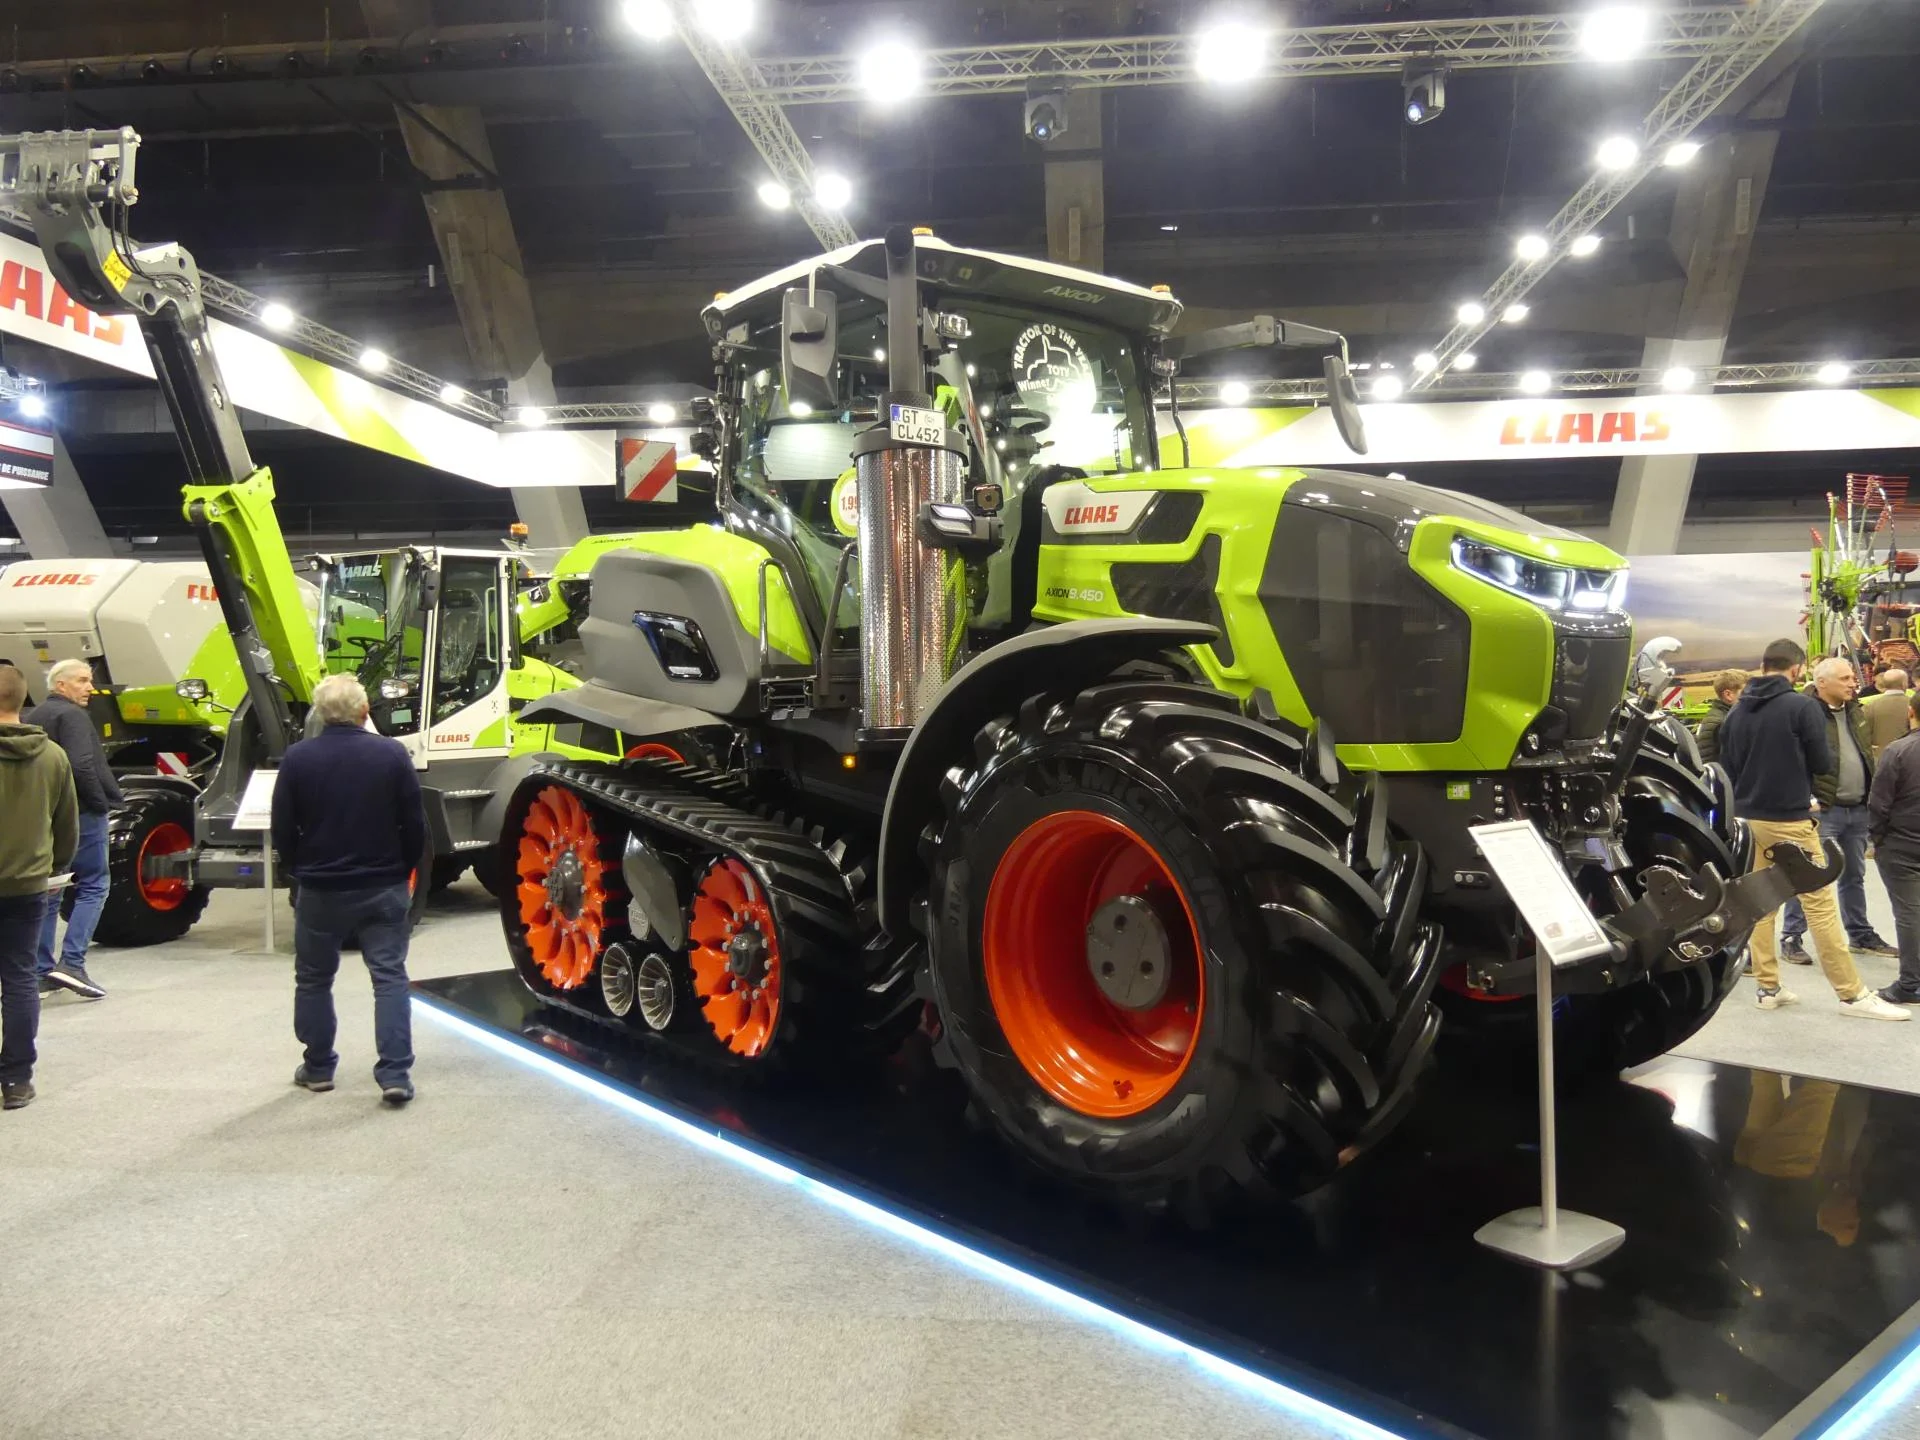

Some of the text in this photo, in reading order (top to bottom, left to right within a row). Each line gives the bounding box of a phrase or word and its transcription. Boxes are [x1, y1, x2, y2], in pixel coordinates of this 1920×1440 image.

[1043, 286, 1106, 304] AXION
[1013, 325, 1042, 370] TRACTOR
[1043, 324, 1056, 335] OF
[1059, 328, 1077, 349] THE
[1017, 380, 1050, 392] Winner
[902, 409, 919, 425] GT
[1499, 411, 1671, 445] CLAAS
[1064, 505, 1120, 525] CLAAS
[12, 573, 99, 588] CLAAS
[1045, 587, 1105, 602] AXION 9.450
[435, 733, 471, 744] CLAAS
